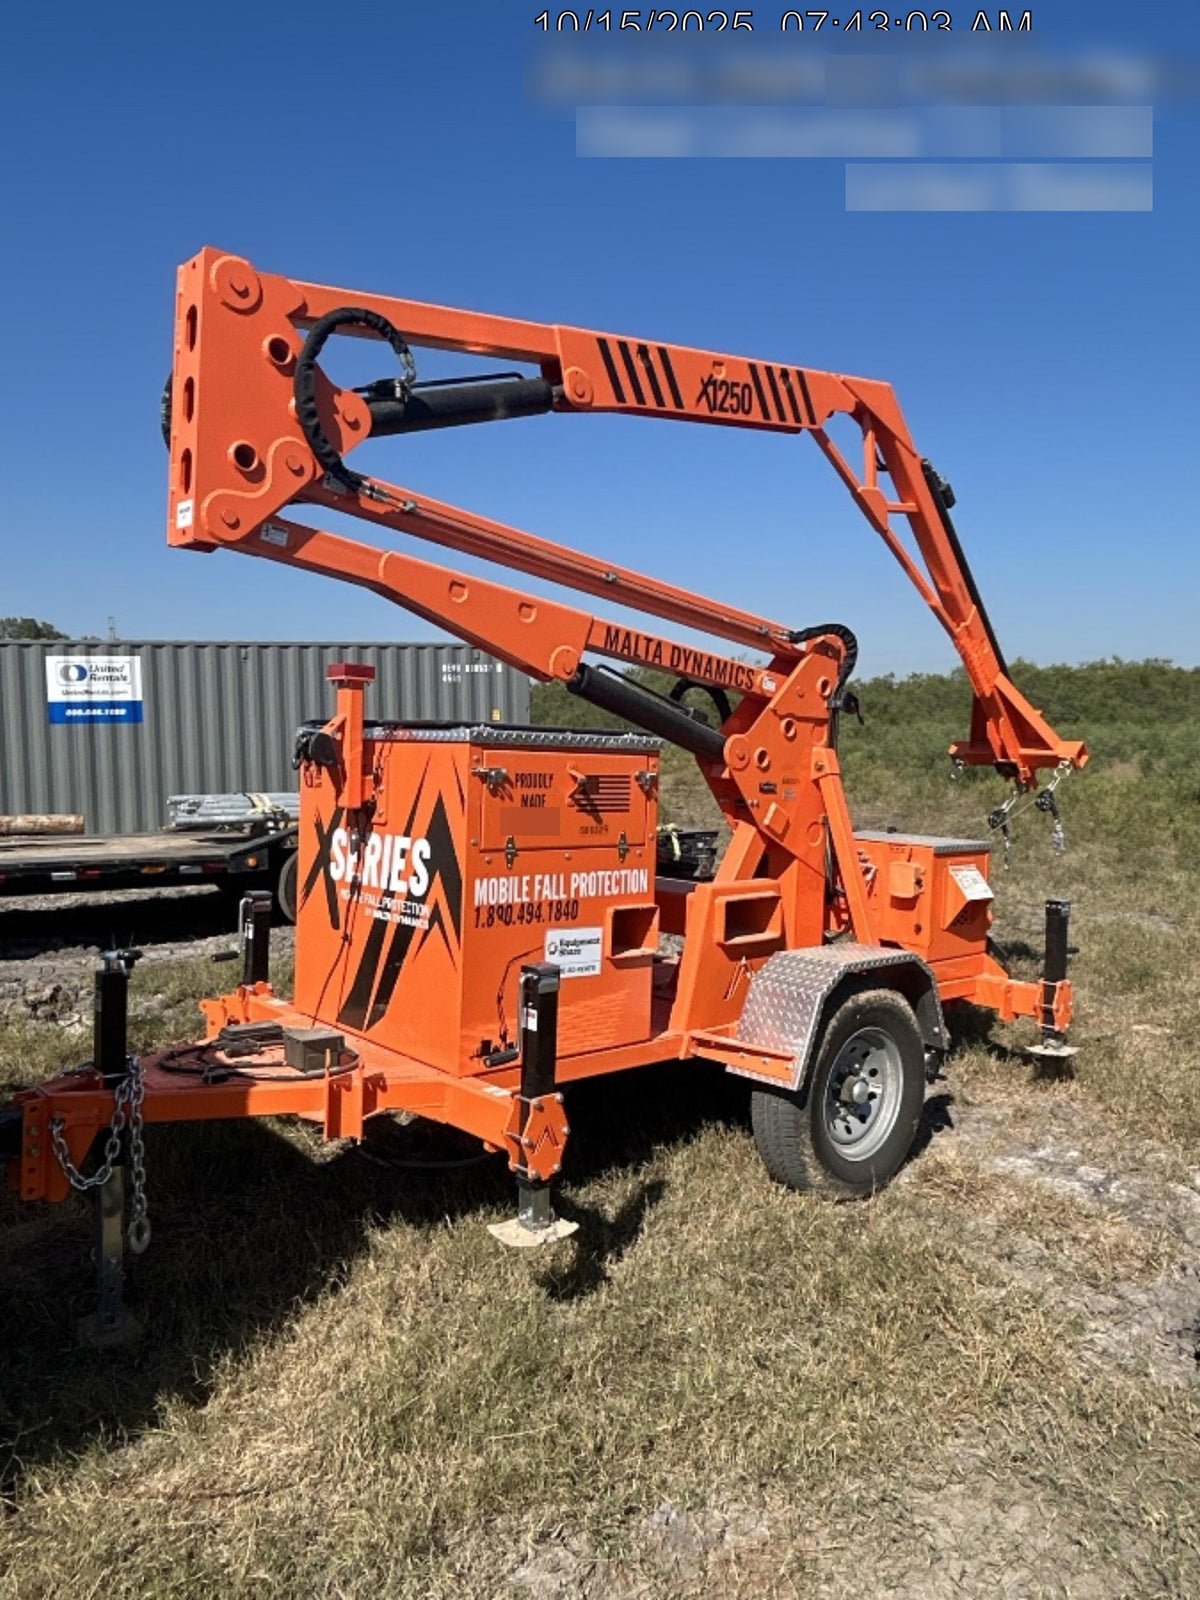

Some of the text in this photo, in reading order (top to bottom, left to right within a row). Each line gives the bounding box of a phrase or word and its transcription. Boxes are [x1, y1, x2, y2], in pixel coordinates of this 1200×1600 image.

[695, 373, 752, 415] X1250
[604, 625, 755, 690] MALTA DYNAMICS
[515, 773, 554, 788] PROUDLY
[520, 794, 546, 807] MADE
[330, 827, 431, 897] SERIES
[474, 869, 649, 906] MOBILE FALL PROTECTION
